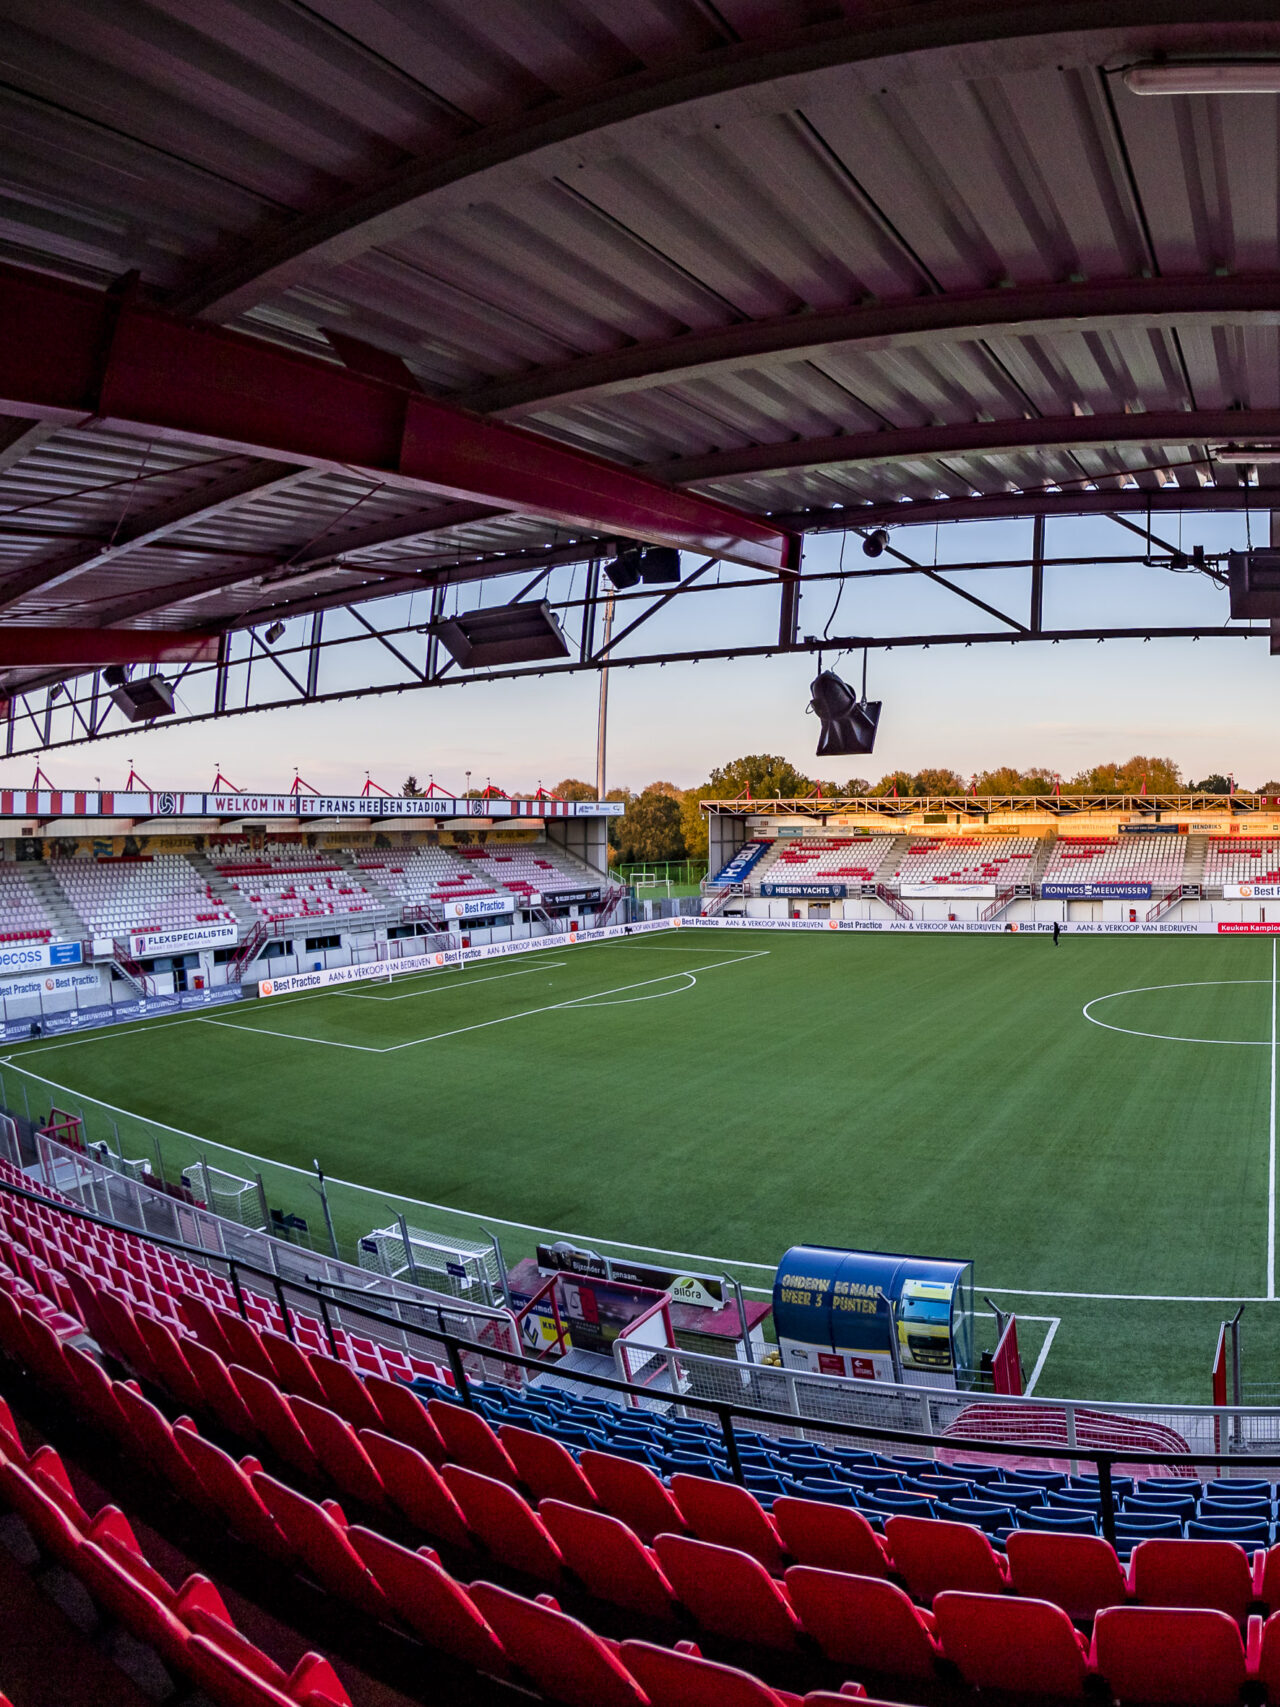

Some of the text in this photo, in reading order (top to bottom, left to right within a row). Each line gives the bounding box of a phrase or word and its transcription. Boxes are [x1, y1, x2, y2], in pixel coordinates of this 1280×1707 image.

[215, 798, 447, 813] WELKOM IN HET FRANS HEESEN STADION
[1045, 886, 1148, 894] KONINGS MEEUWISSEN
[1254, 886, 1274, 896] Best
[464, 900, 505, 914] Best Practice
[695, 918, 719, 926] Practice
[748, 920, 776, 928] VERKOOP
[777, 920, 791, 928] VAN
[792, 921, 824, 929] BEDRIJVEN
[839, 921, 854, 929] Best
[855, 921, 883, 929] Practice
[916, 922, 948, 930] VERKOOP
[949, 922, 965, 930] VAN
[966, 923, 1002, 931] BEDRIJVEN
[1019, 922, 1036, 931] Best
[1037, 922, 1068, 931] Pracce
[1097, 924, 1103, 932] &
[1104, 923, 1140, 932] VERKOOP
[1141, 924, 1158, 932] VAN
[1159, 924, 1198, 932] BEDRIJVEN
[148, 928, 234, 945] FLEXSPECIALISTEN
[273, 981, 290, 992] Best
[291, 975, 321, 989] Practice
[353, 966, 385, 979] VERKOOP
[400, 957, 431, 971] BEDRIJVEN
[444, 952, 458, 963] Best
[507, 942, 531, 952] VERKOOP
[531, 940, 542, 948] VAN
[576, 932, 586, 941] Best
[586, 929, 605, 939] Practice
[13, 983, 41, 995] Practice
[55, 977, 71, 989] Best
[573, 1261, 600, 1273] Bijzonder
[673, 1286, 702, 1299] allora
[849, 1283, 883, 1299] NAAR
[781, 1288, 811, 1306] WEER
[832, 1295, 878, 1314] PUNTEN
